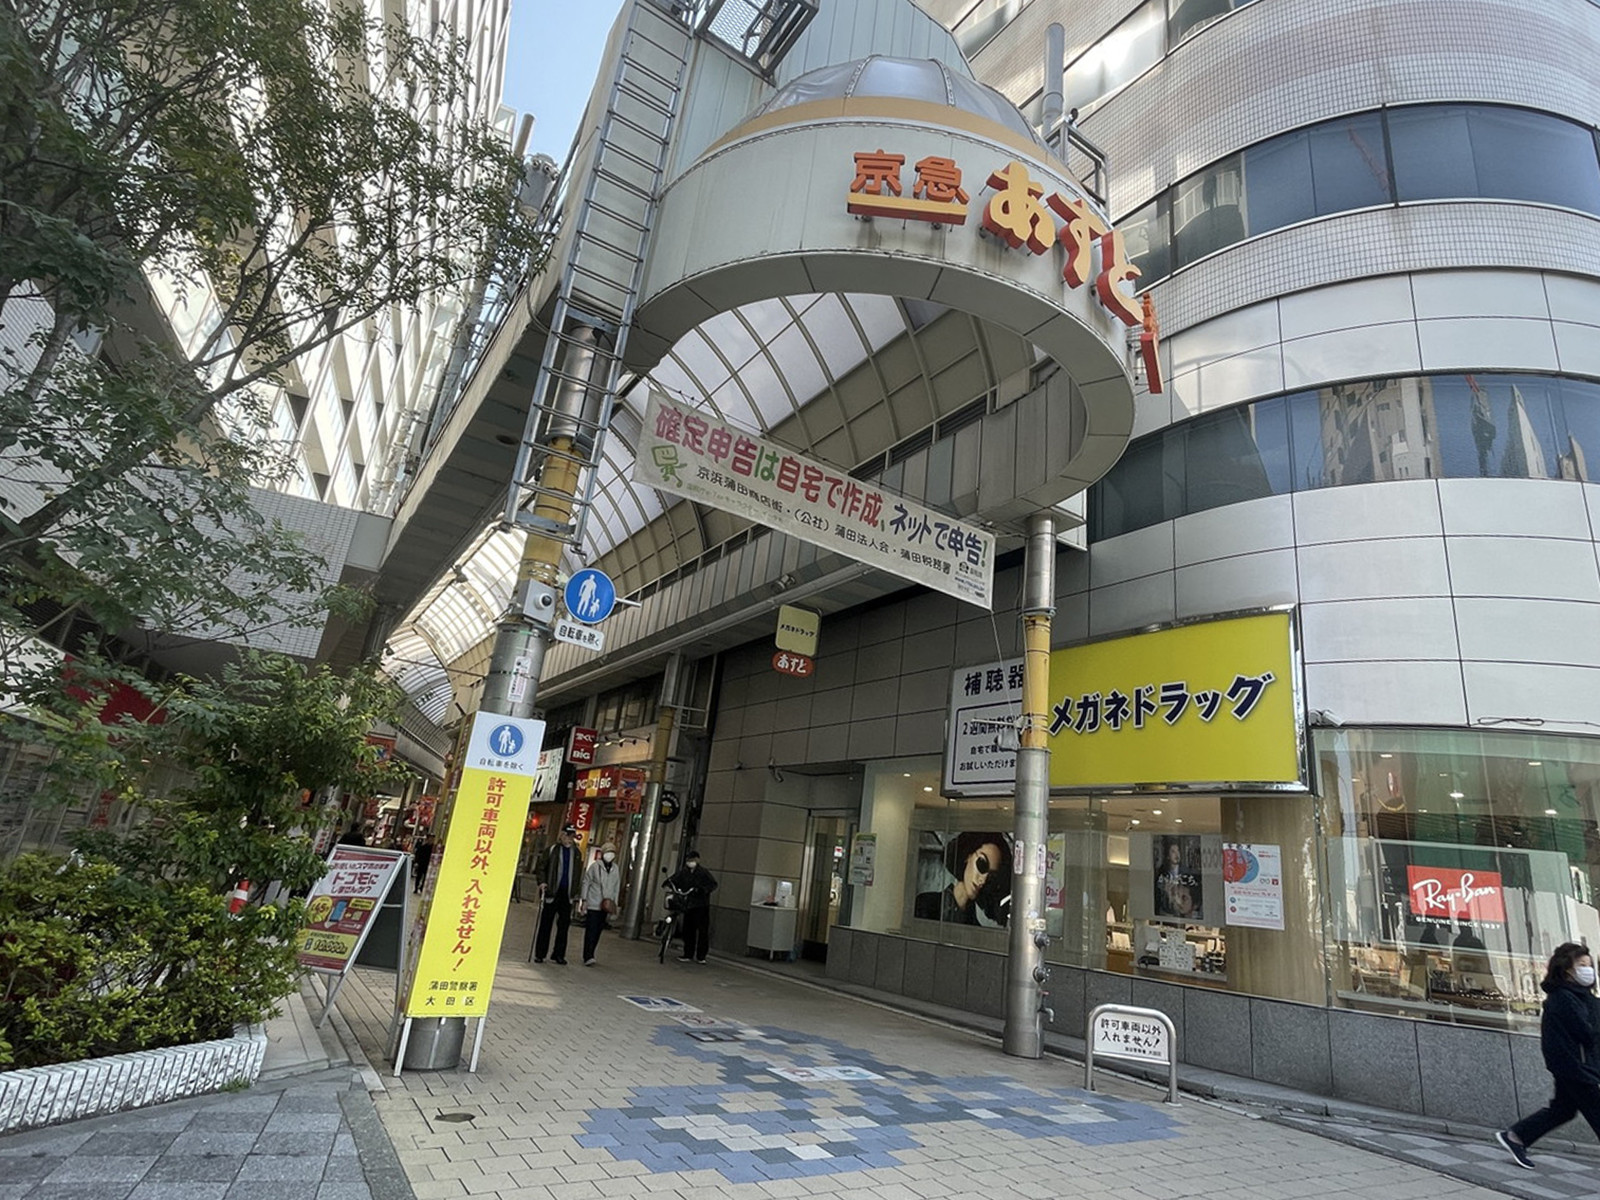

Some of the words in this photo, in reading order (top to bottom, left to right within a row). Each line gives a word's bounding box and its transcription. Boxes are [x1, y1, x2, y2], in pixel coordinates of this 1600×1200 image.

[850, 148, 970, 204] 京急
[982, 161, 1143, 327] あすと
[558, 625, 600, 647] 自転車を除く
[779, 623, 815, 638] メガネドラッグ
[777, 654, 806, 674] あすと
[964, 664, 1024, 696] 補聴器
[1049, 671, 1275, 736] メガネドラッグ
[479, 757, 524, 771] 自転車を除く
[332, 871, 379, 885] ドコモに
[1415, 916, 1451, 926] GENUINE
[1454, 919, 1478, 927] SINCE
[428, 980, 478, 992] 蒲田警察署
[425, 995, 475, 1006] 大田区
[1101, 1018, 1162, 1036] 許可車両以外
